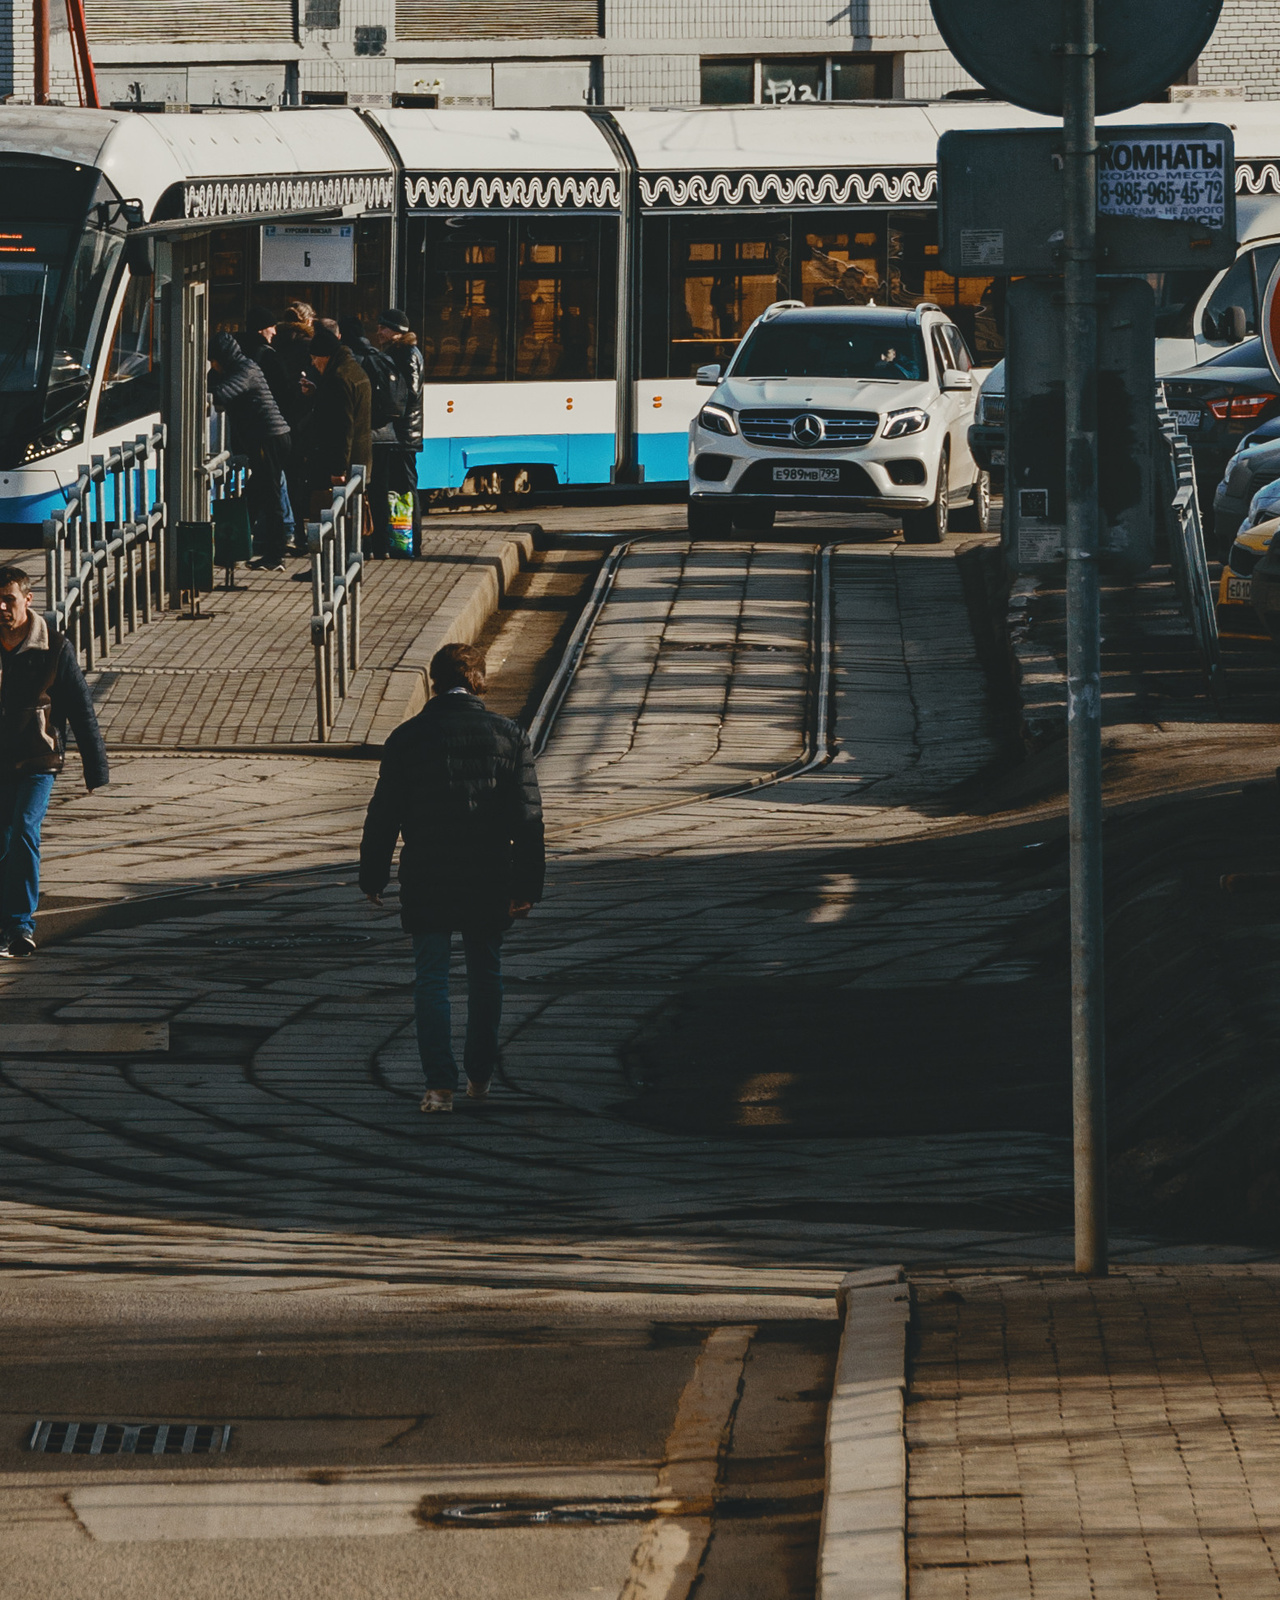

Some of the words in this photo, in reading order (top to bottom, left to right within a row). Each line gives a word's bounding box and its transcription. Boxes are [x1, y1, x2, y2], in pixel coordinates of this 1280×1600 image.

[1100, 143, 1223, 170] КОМНАТЫ
[1099, 170, 1223, 180] КОЙКО-МЕСТА
[1100, 180, 1223, 205] 8-985-965-45-72
[1165, 206, 1178, 214] НЕ
[1181, 206, 1224, 215] ДОРОГО
[304, 251, 311, 267] Б
